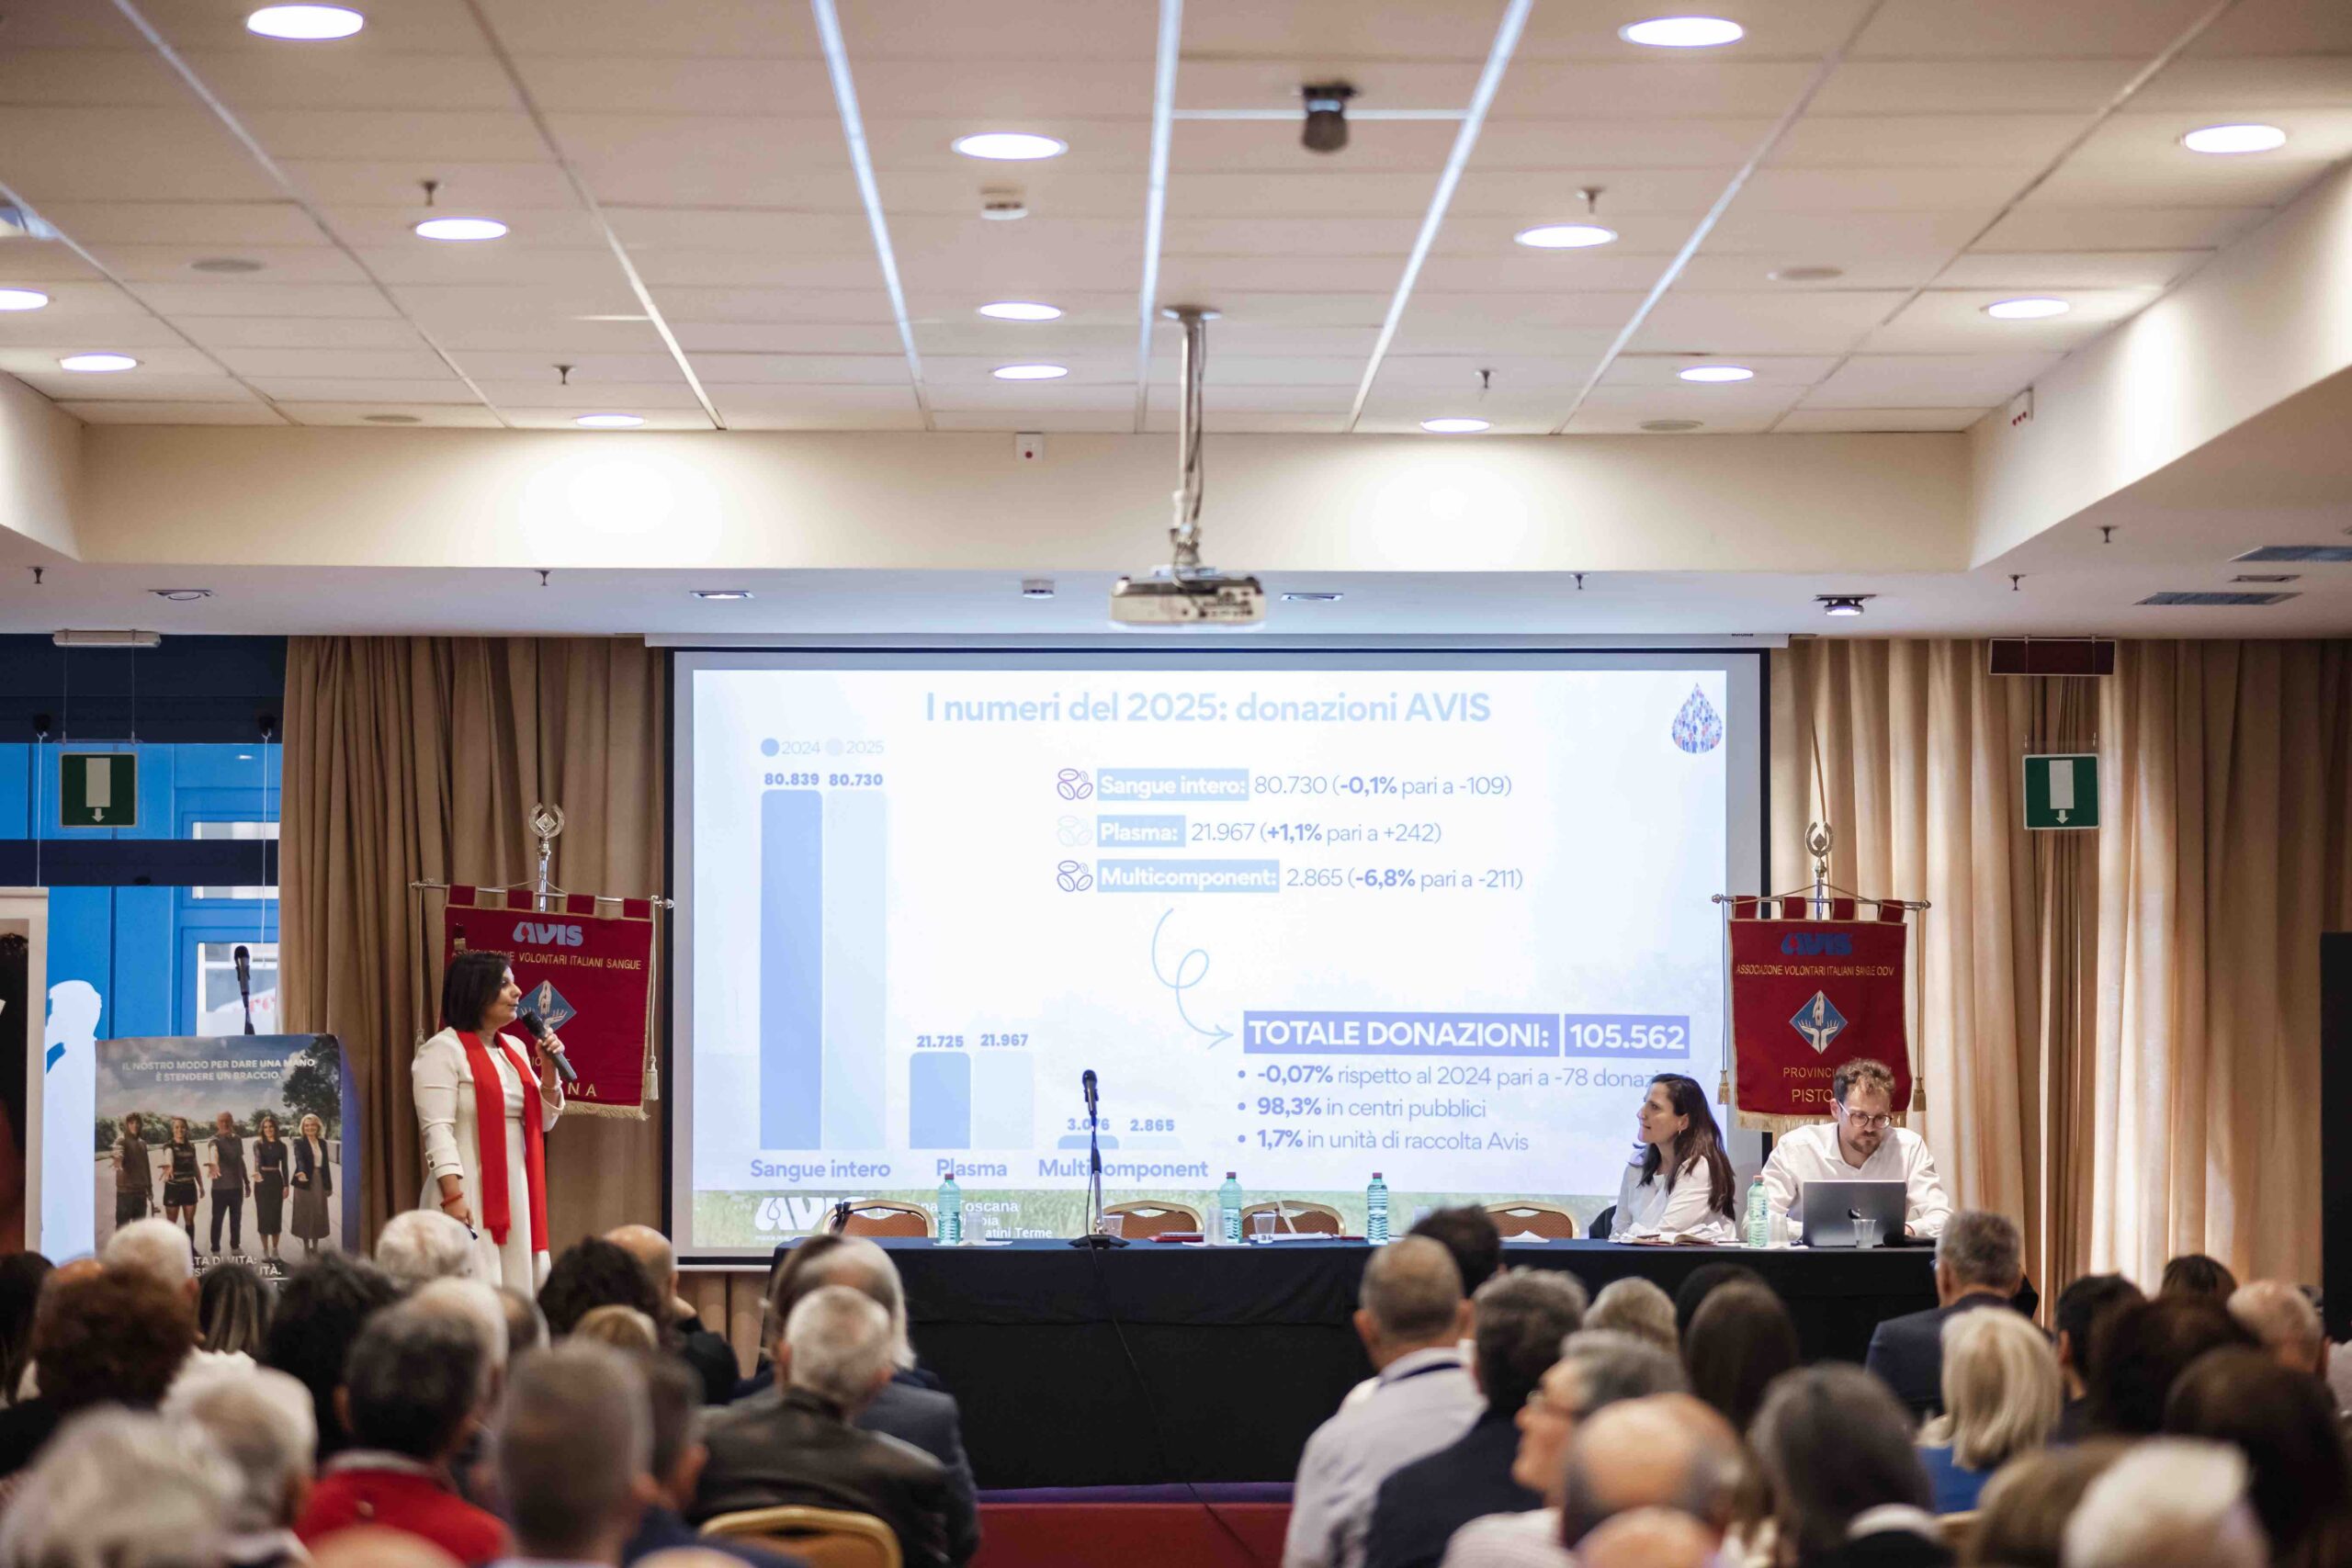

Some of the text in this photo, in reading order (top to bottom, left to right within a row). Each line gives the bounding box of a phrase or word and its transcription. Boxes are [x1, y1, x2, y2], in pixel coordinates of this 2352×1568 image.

[927, 693, 1493, 723] I numeri del 2025: donazioni AVIS
[782, 741, 885, 755] 2024 2025
[764, 773, 884, 786] 80.839 80.730
[1102, 775, 1512, 801] Sangue intero: 80.730 (-0,1% pari a -109)
[1101, 823, 1442, 848] Plasma: 21.967 (+1,1% pari a +242)
[1102, 867, 1523, 894] Multicomponent: 2.865 (-6,8% pari a -211)
[513, 921, 583, 946] AVIS
[1781, 932, 1853, 956] AVIS
[519, 953, 567, 964] VOLONTARI
[570, 956, 603, 968] ITALIANI
[606, 958, 641, 970] SANGUE
[1785, 965, 1826, 976] VOLONTARI
[1827, 965, 1854, 976] ITALIANI
[1877, 966, 1894, 976] ODV
[916, 1034, 1029, 1048] 21.725 21.967
[1249, 1021, 1685, 1050] TOTALE DONAZIONI: 105.562
[132, 1061, 175, 1071] NOSTRO
[176, 1060, 209, 1070] MODO
[211, 1060, 230, 1069] PER
[232, 1059, 257, 1068] DARE
[260, 1059, 281, 1067] UNA
[283, 1058, 315, 1067] MANO
[1783, 1067, 1836, 1078] PROVINCI
[164, 1072, 214, 1081] STENDERE
[216, 1072, 232, 1080] UN
[233, 1071, 281, 1080] BRACCIO.
[1258, 1065, 1334, 1088] -0,07%
[1339, 1066, 1412, 1090] rispetto
[1418, 1066, 1432, 1086] al
[1438, 1066, 1493, 1087] 2024
[1498, 1068, 1532, 1091] pari
[1539, 1073, 1550, 1088] a
[1555, 1068, 1589, 1088] -78
[1792, 1089, 1834, 1102] PISTO
[1258, 1097, 1487, 1122] 98,3% in centri pubblici
[1067, 1118, 1175, 1132] 3.06 2.865
[1258, 1130, 1530, 1152] 1,7% in unità di raccolta Avis
[751, 1159, 891, 1184] Sangue intero
[937, 1158, 1008, 1179] Plasma
[1038, 1158, 1209, 1182] Multiomponent
[1014, 1227, 1053, 1238] Terme
